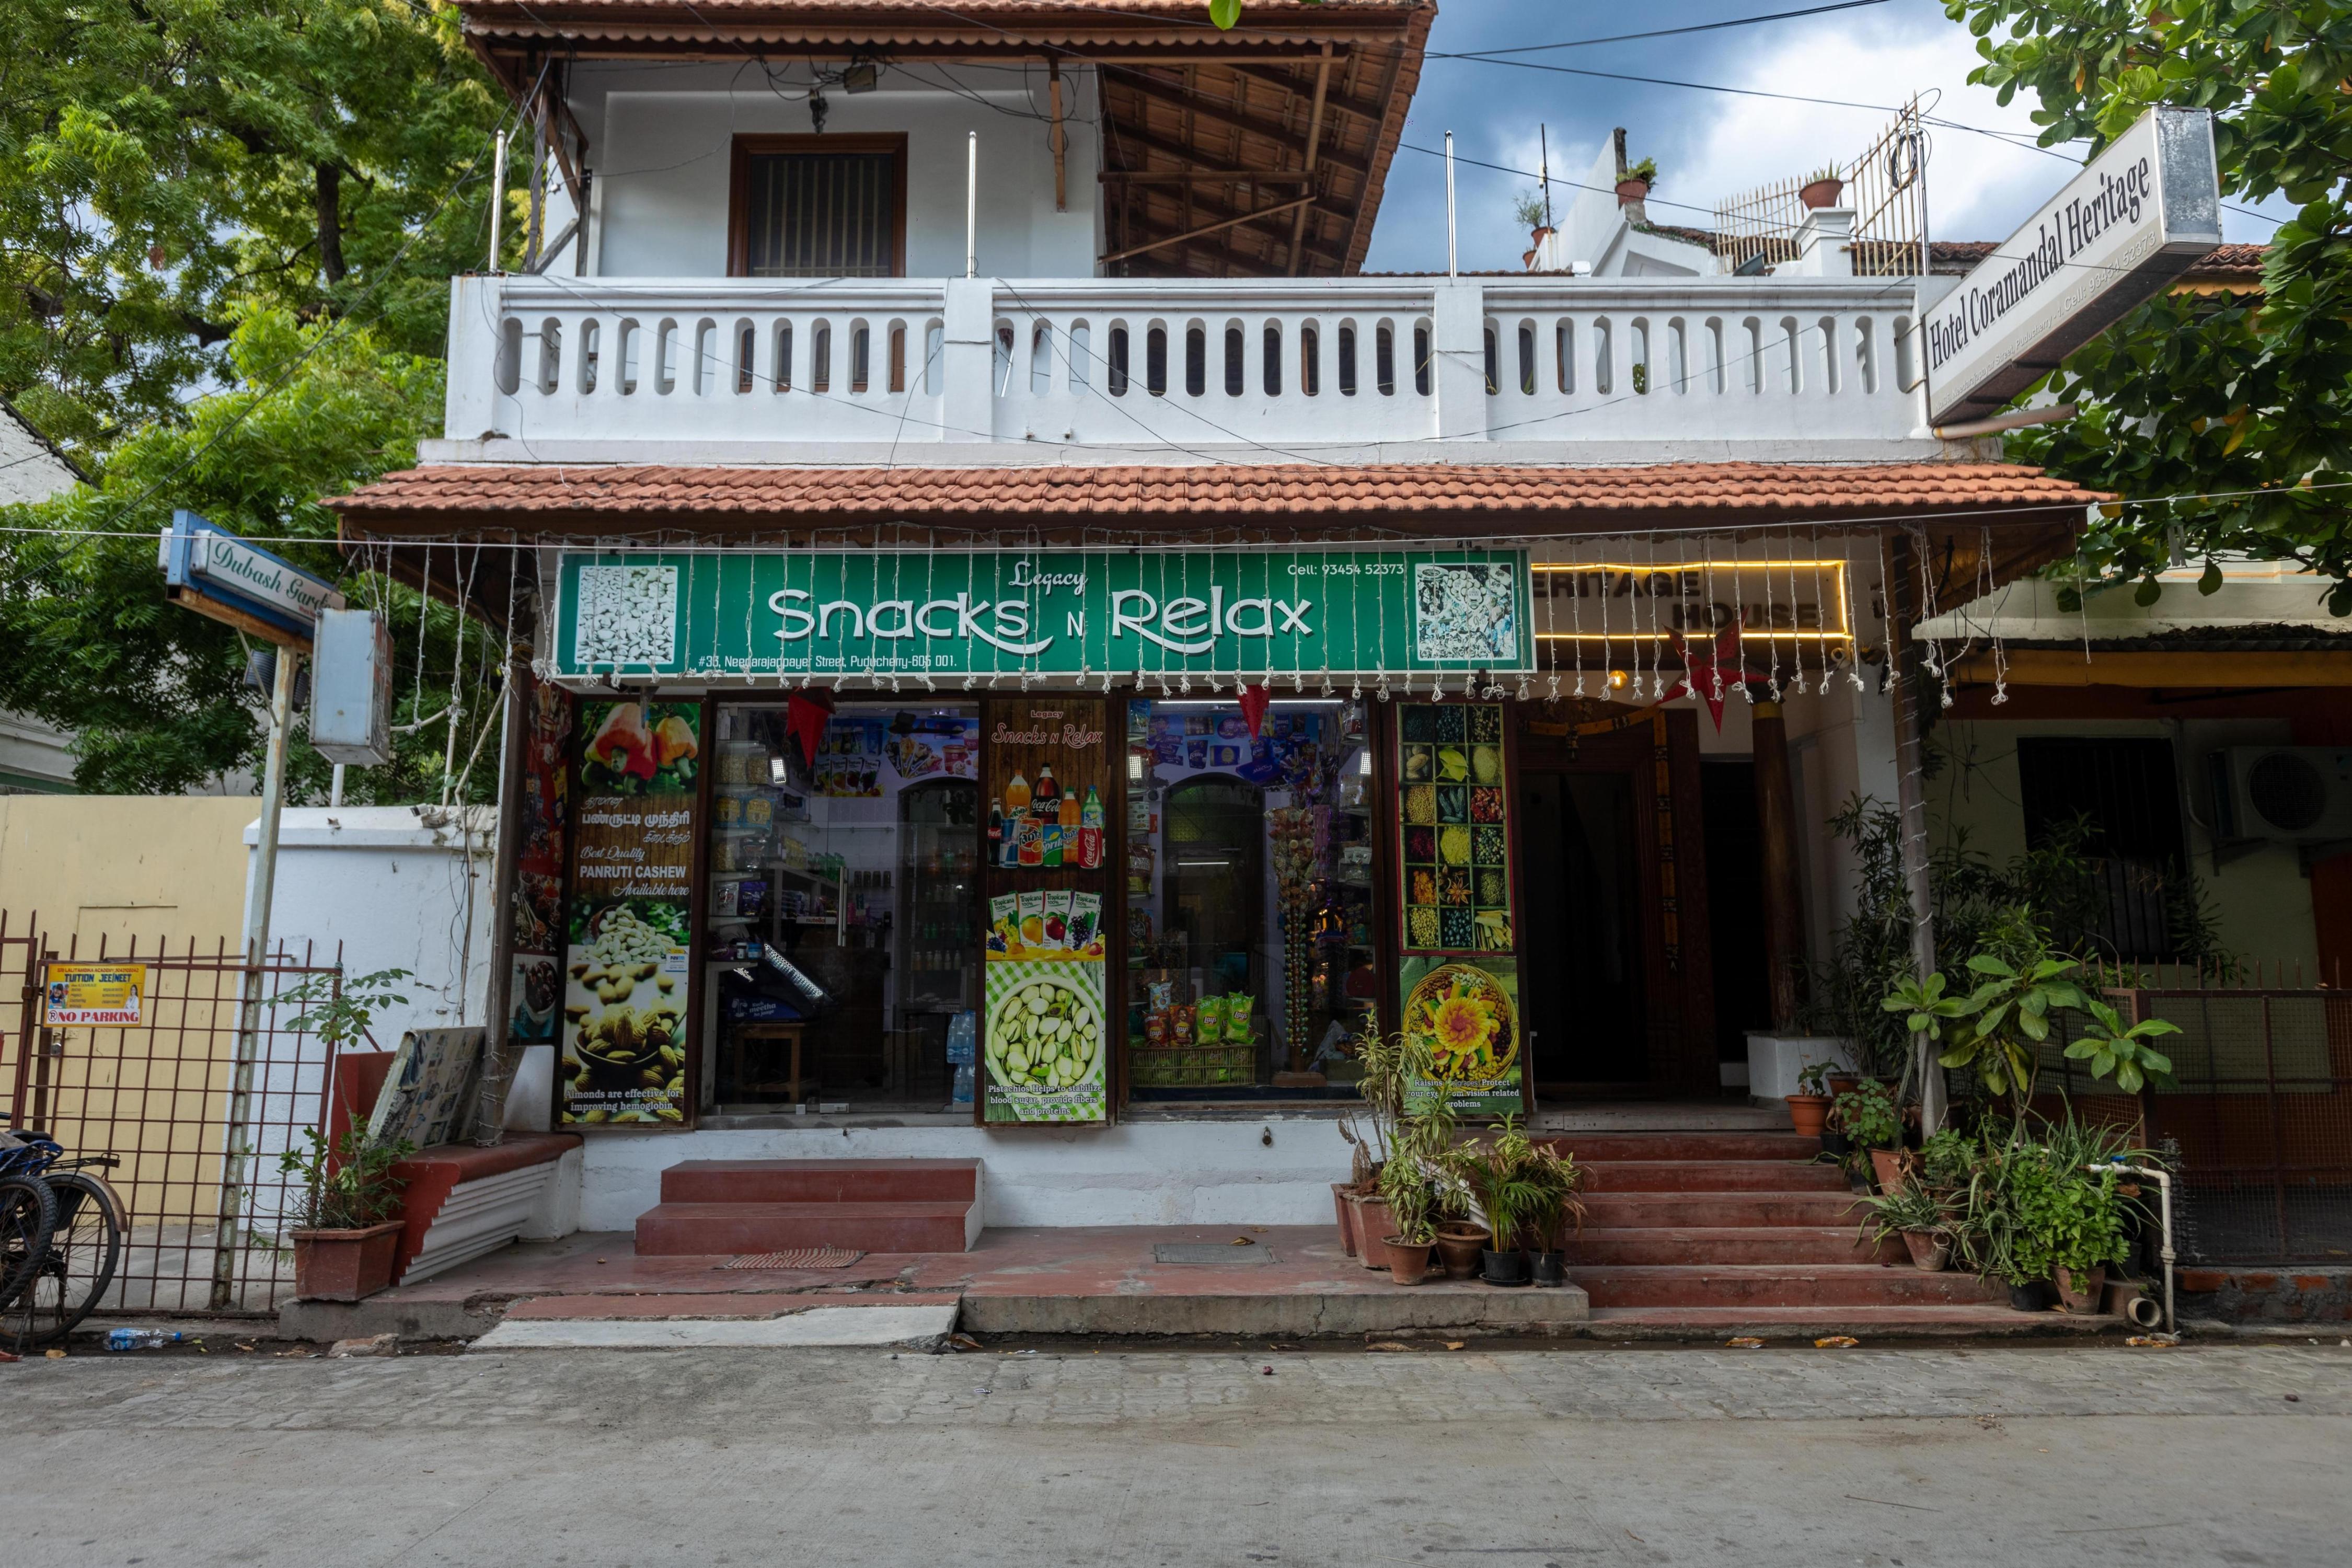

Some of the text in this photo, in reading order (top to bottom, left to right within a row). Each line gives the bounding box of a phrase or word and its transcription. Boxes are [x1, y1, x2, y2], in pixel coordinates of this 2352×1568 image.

[1930, 157, 2150, 370] Hotel Coramandal Heritage
[2015, 316, 2053, 348] Puducherry
[2065, 288, 2086, 312] Cell:
[2090, 258, 2119, 292] 93454
[2123, 231, 2155, 267] 52373
[213, 542, 283, 593] Dubash
[1287, 564, 1404, 575] Cell: 93454 52373
[1008, 561, 1088, 595] Legacy
[1532, 571, 1700, 598] ERITAGE
[768, 586, 1313, 654] Snacks N Relax
[1673, 603, 1819, 629] HOUSE
[815, 655, 846, 668] Street,
[935, 655, 957, 667] 001.
[1031, 710, 1064, 719] Legacy
[991, 722, 1103, 749] Snacks N Relax
[582, 810, 690, 828] பண்ருட்டி முந்திரி
[643, 830, 690, 845] கிடைக்கும்
[580, 845, 645, 862] Best Quality
[580, 866, 686, 878] PANRUTI CASHEW
[613, 880, 690, 897] Available here
[994, 897, 1014, 906] Tropicana
[1076, 894, 1097, 904] Tropicana
[65, 974, 132, 983] TUITION JEE/NEET
[749, 1003, 777, 1013] meetha
[59, 1011, 139, 1022] NO PARKING
[1235, 1011, 1248, 1020] Lay's
[565, 1089, 605, 1099] Almonds
[625, 1089, 664, 1098] effective
[667, 1088, 680, 1097] for
[1032, 1085, 1055, 1093] Helps
[1068, 1084, 1102, 1092] stabilize
[1042, 1096, 1072, 1105] provide
[570, 1101, 673, 1113] improving hemoglobin
[1036, 1107, 1071, 1116] proteins
